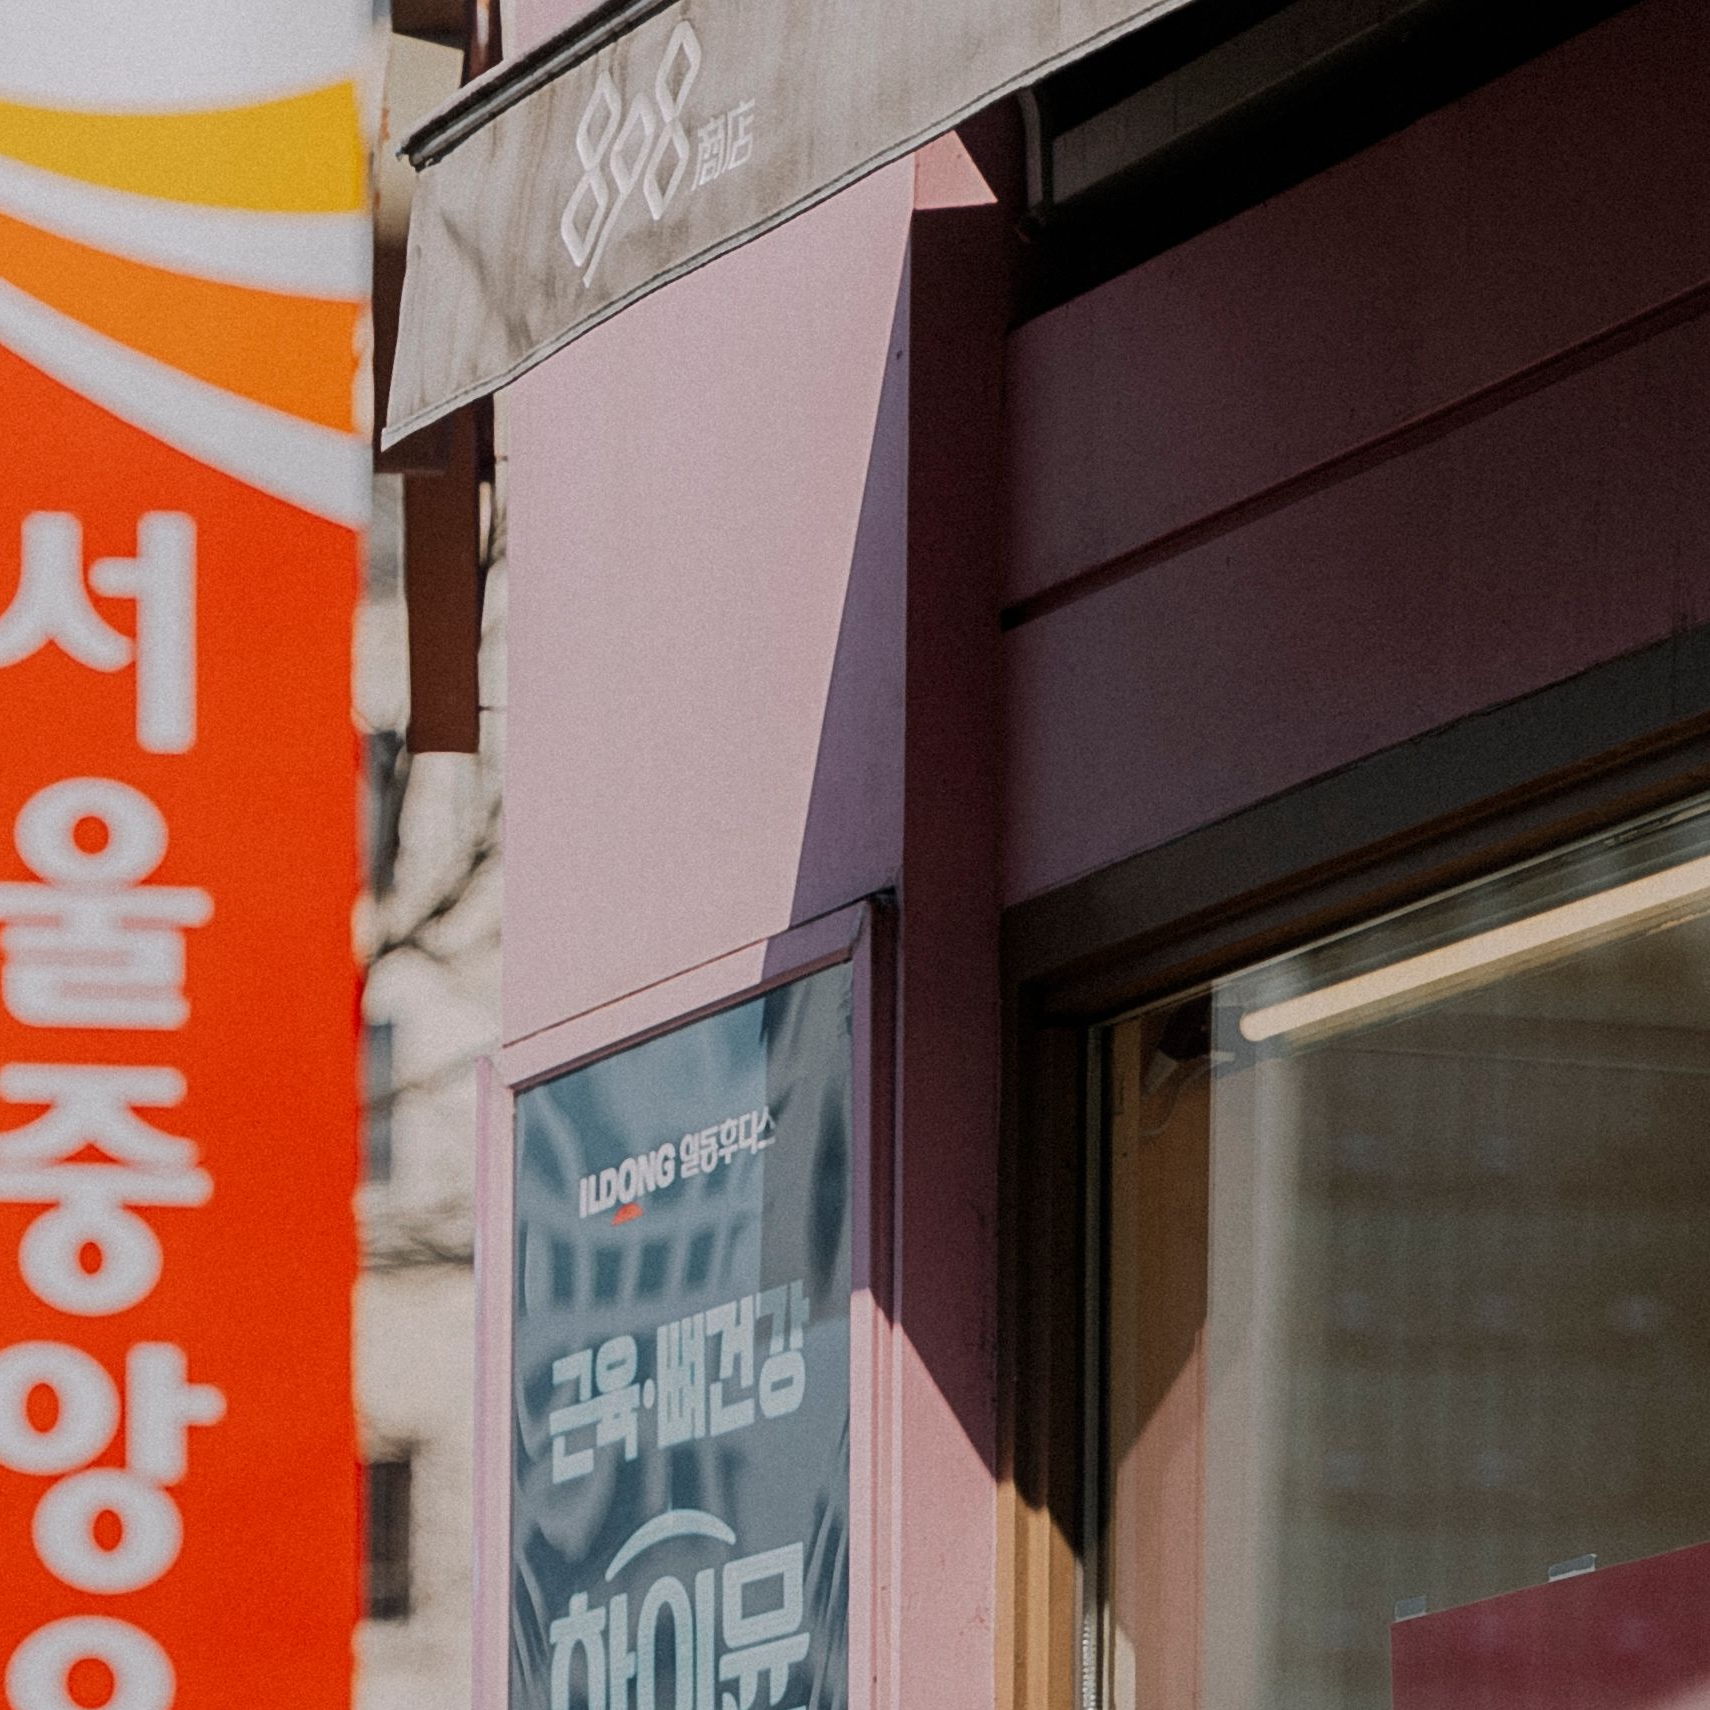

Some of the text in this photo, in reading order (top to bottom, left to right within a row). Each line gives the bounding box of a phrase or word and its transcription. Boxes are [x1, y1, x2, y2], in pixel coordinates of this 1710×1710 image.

[691, 98, 756, 191] 商店
[579, 1105, 776, 1219] ILDONG 일동후디스
